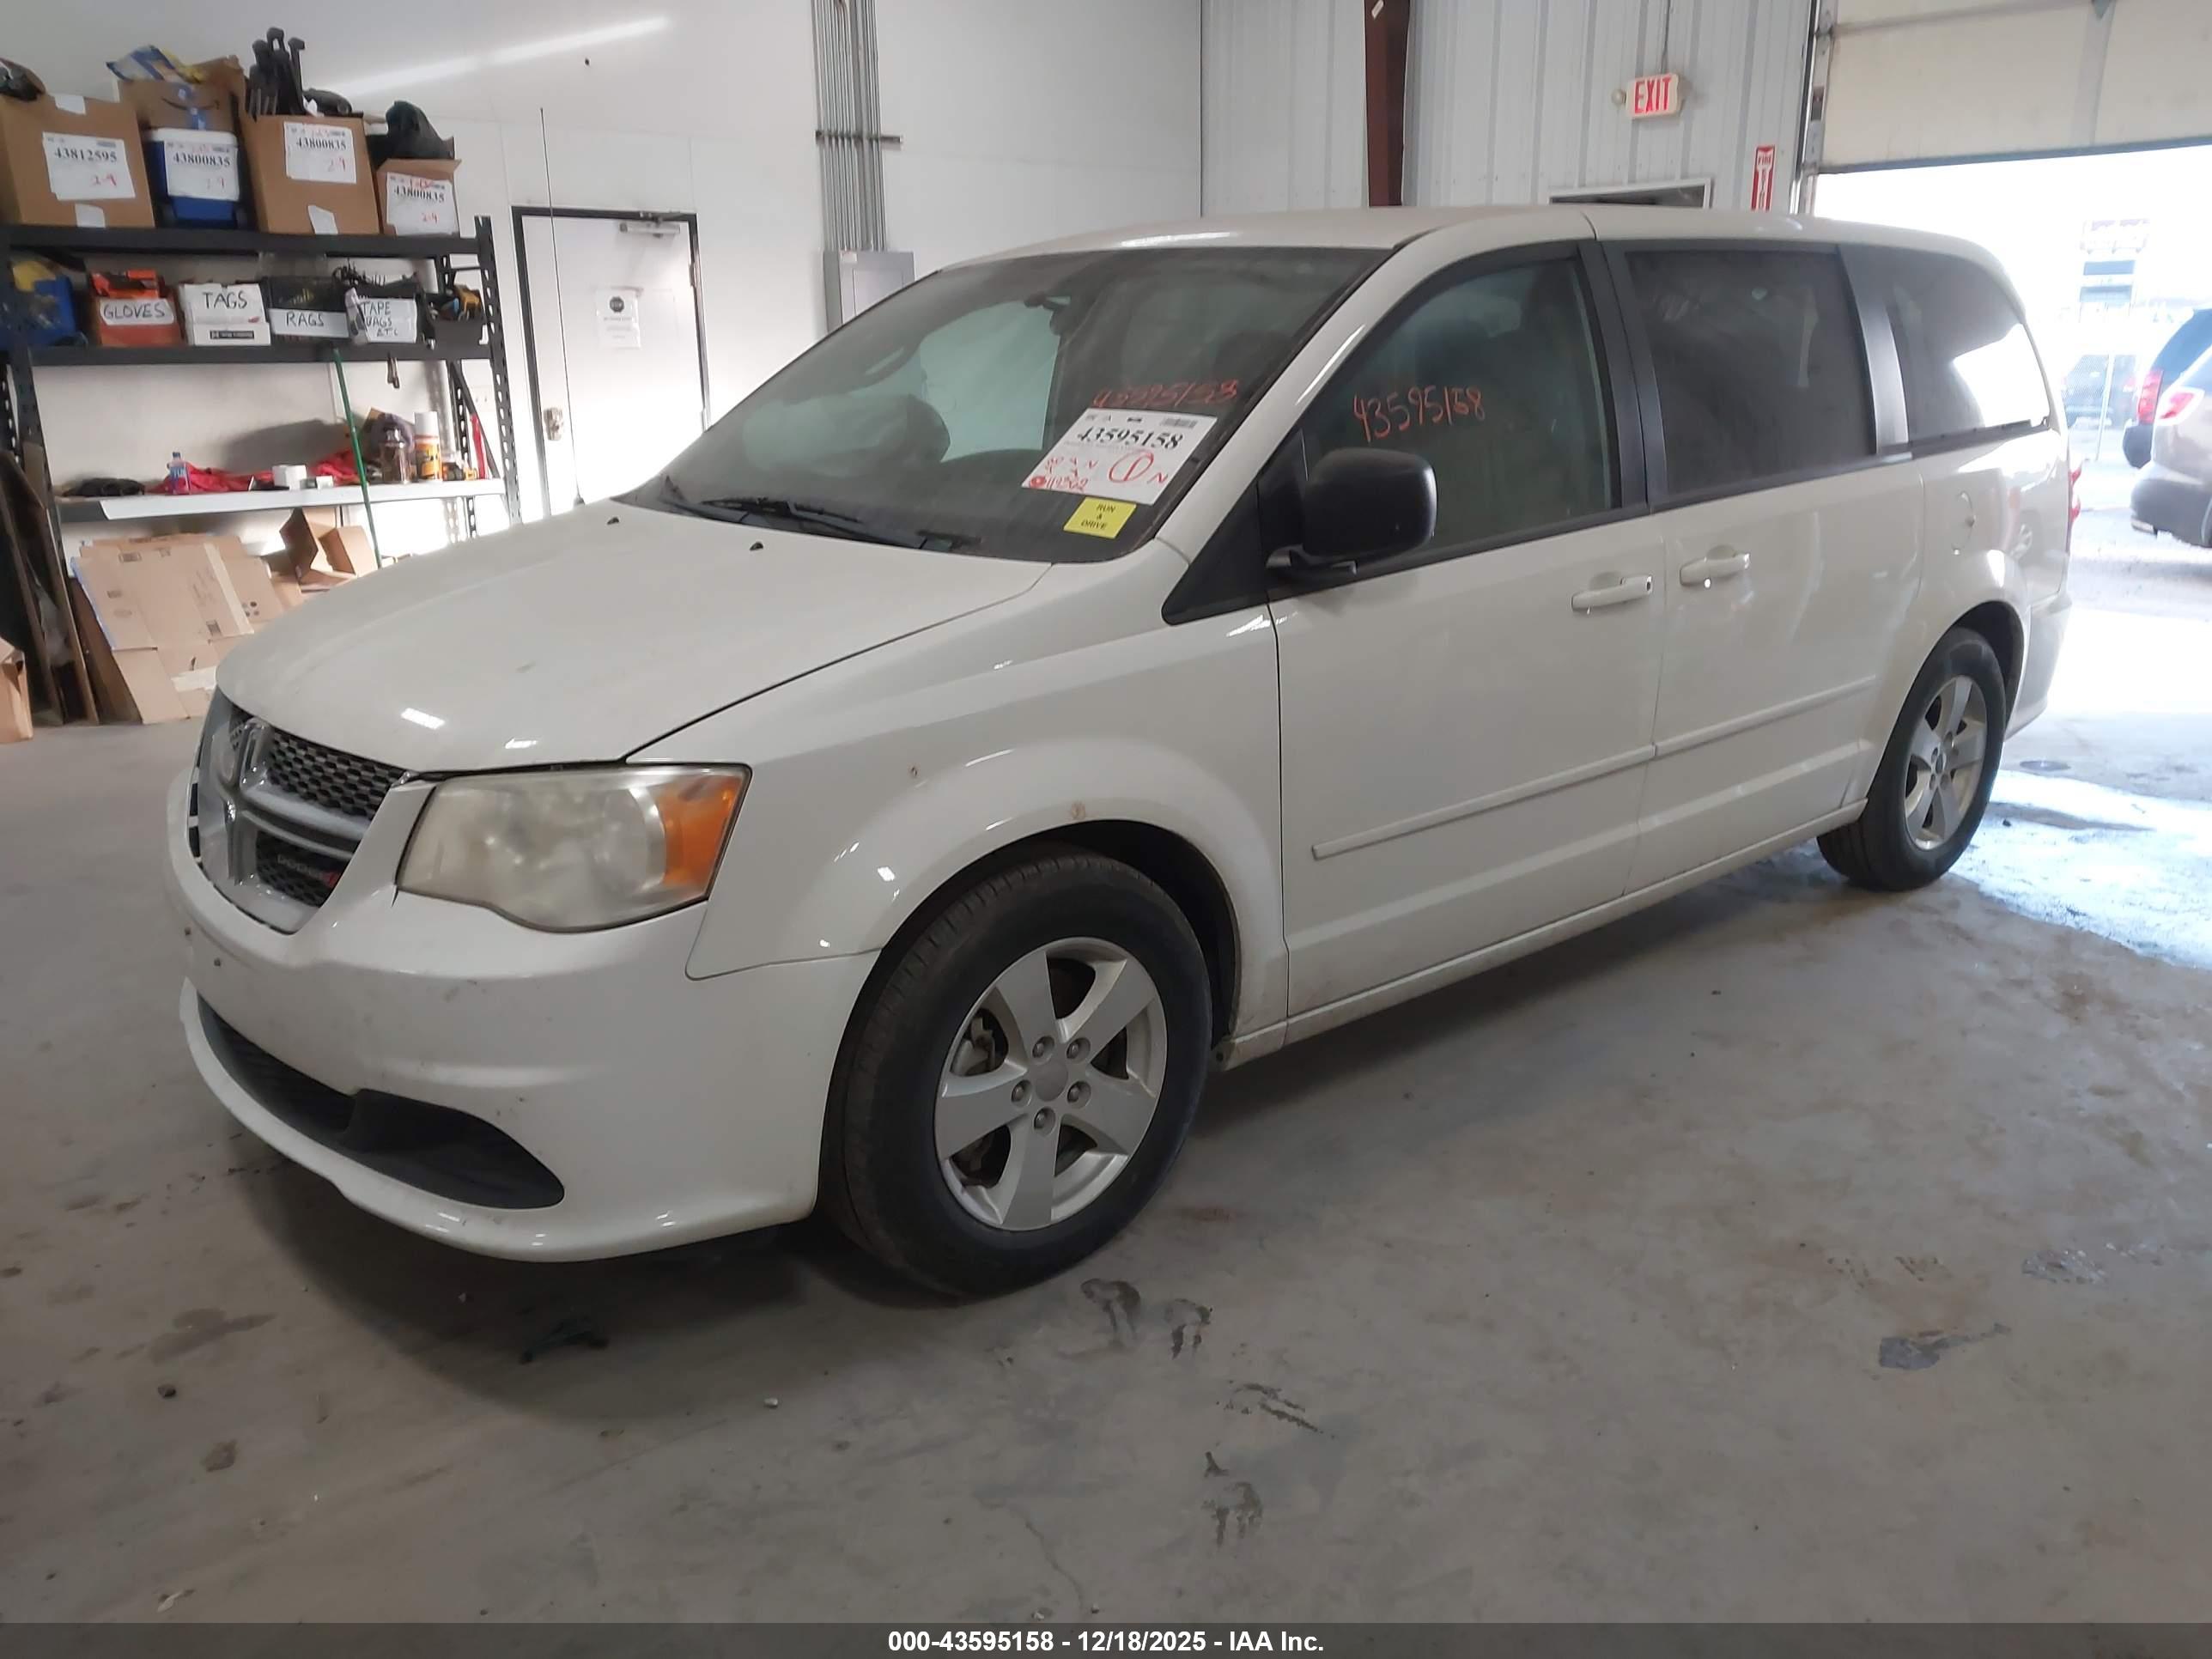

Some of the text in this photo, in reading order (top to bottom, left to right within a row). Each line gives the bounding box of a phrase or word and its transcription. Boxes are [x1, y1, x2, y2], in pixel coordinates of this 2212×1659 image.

[1635, 76, 1671, 113] EXIT
[296, 137, 346, 150] 43800835
[55, 148, 118, 163] 43812595
[173, 152, 230, 167] 43800835
[393, 185, 445, 203] 43800835
[203, 290, 247, 309] TAGS
[103, 302, 165, 319] GLOVES
[362, 301, 391, 317] TAPE
[286, 311, 324, 327] RAGS
[1077, 426, 1184, 450] 43595158
[1097, 504, 1116, 513] RUN
[1080, 520, 1107, 530] DRIVE
